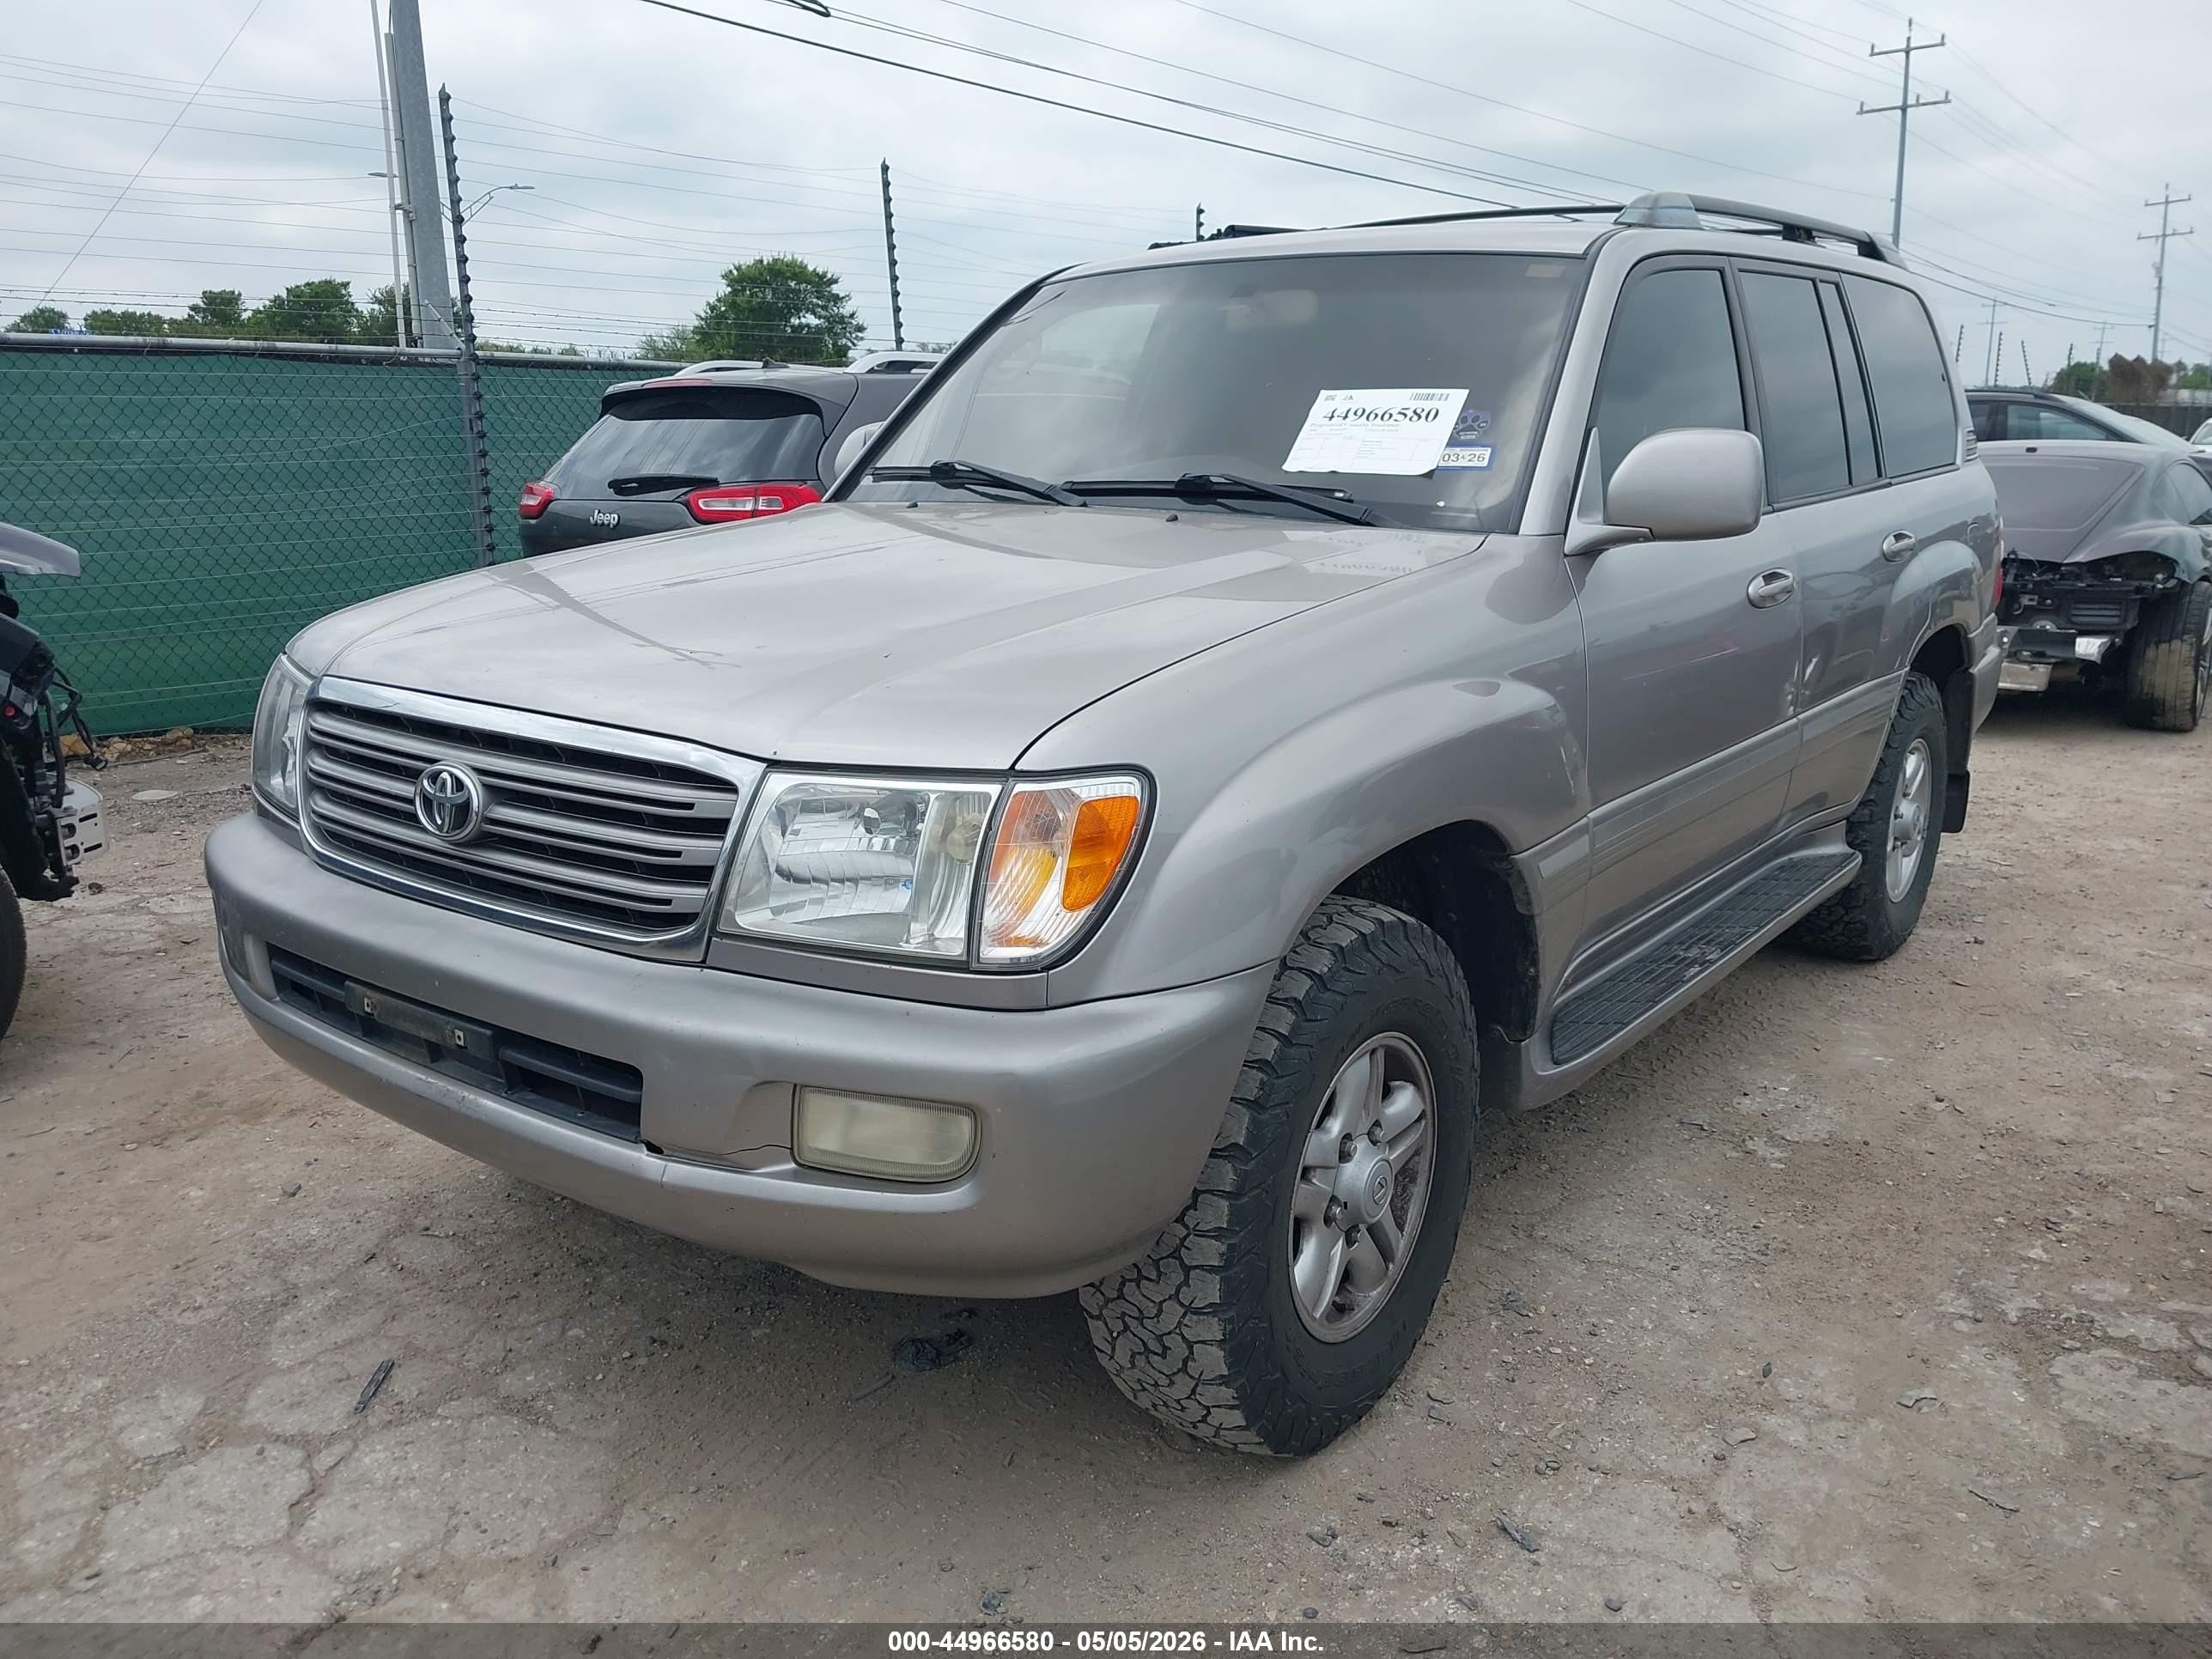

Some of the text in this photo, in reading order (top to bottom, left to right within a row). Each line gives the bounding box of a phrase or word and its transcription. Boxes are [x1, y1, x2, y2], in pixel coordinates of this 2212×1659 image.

[1322, 406, 1440, 422] 44966580
[1442, 453, 1486, 462] 03 26
[589, 509, 619, 528] Jeep
